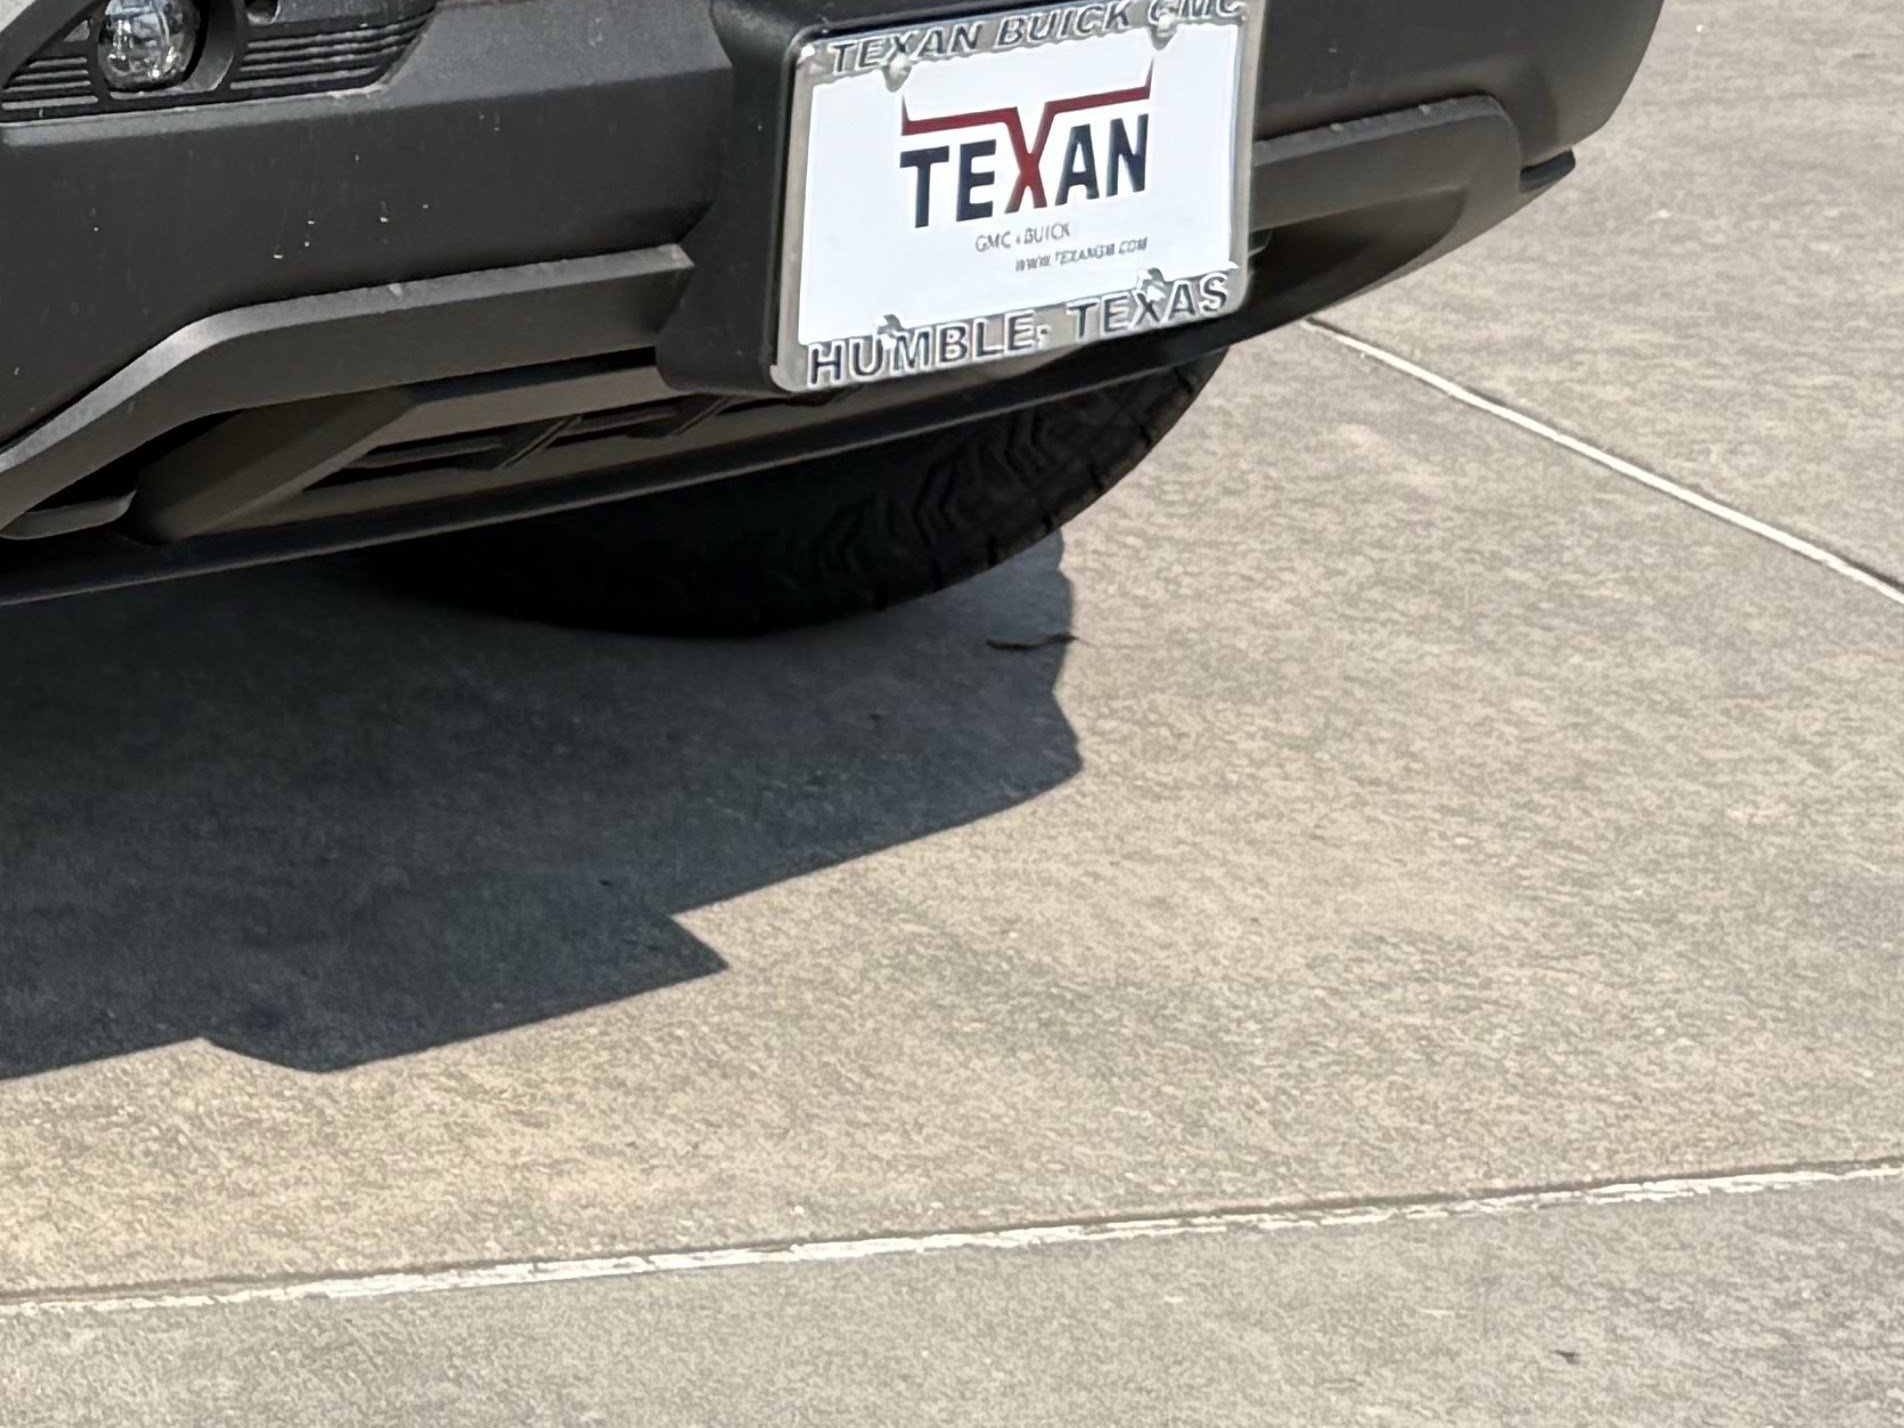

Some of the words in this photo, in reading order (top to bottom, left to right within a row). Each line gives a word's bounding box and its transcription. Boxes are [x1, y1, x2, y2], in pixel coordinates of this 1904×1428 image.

[830, 32, 985, 75] TEXAN
[996, 1, 1134, 48] BUICK
[898, 101, 1152, 229] TEXAN
[975, 230, 1012, 252] GMC
[1024, 223, 1071, 245] BUICK
[1067, 274, 1230, 341] TEXAS
